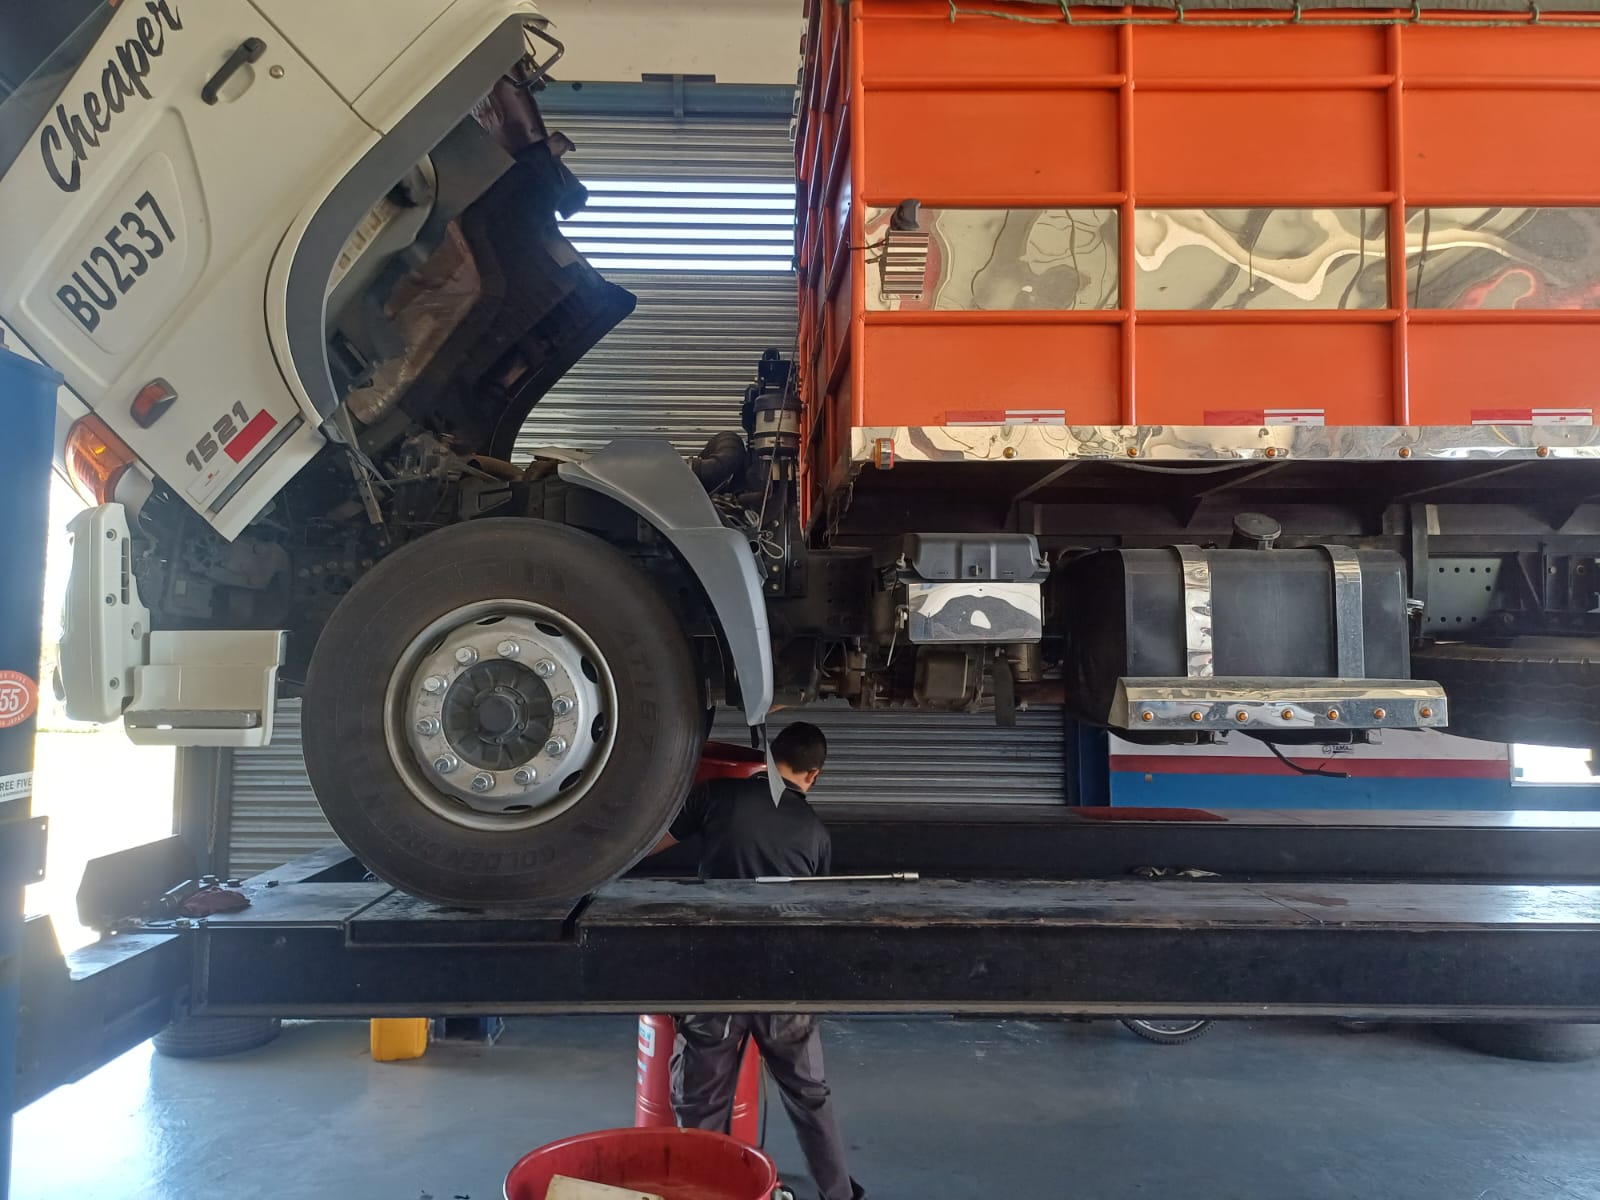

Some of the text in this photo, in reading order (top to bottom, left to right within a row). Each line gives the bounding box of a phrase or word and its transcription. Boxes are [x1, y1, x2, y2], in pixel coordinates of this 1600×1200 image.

[40, 0, 183, 192] Cheaper
[56, 190, 176, 333] BU2537
[185, 400, 249, 472] 1521
[0, 688, 21, 711] 55
[17, 776, 33, 789] FIVE
